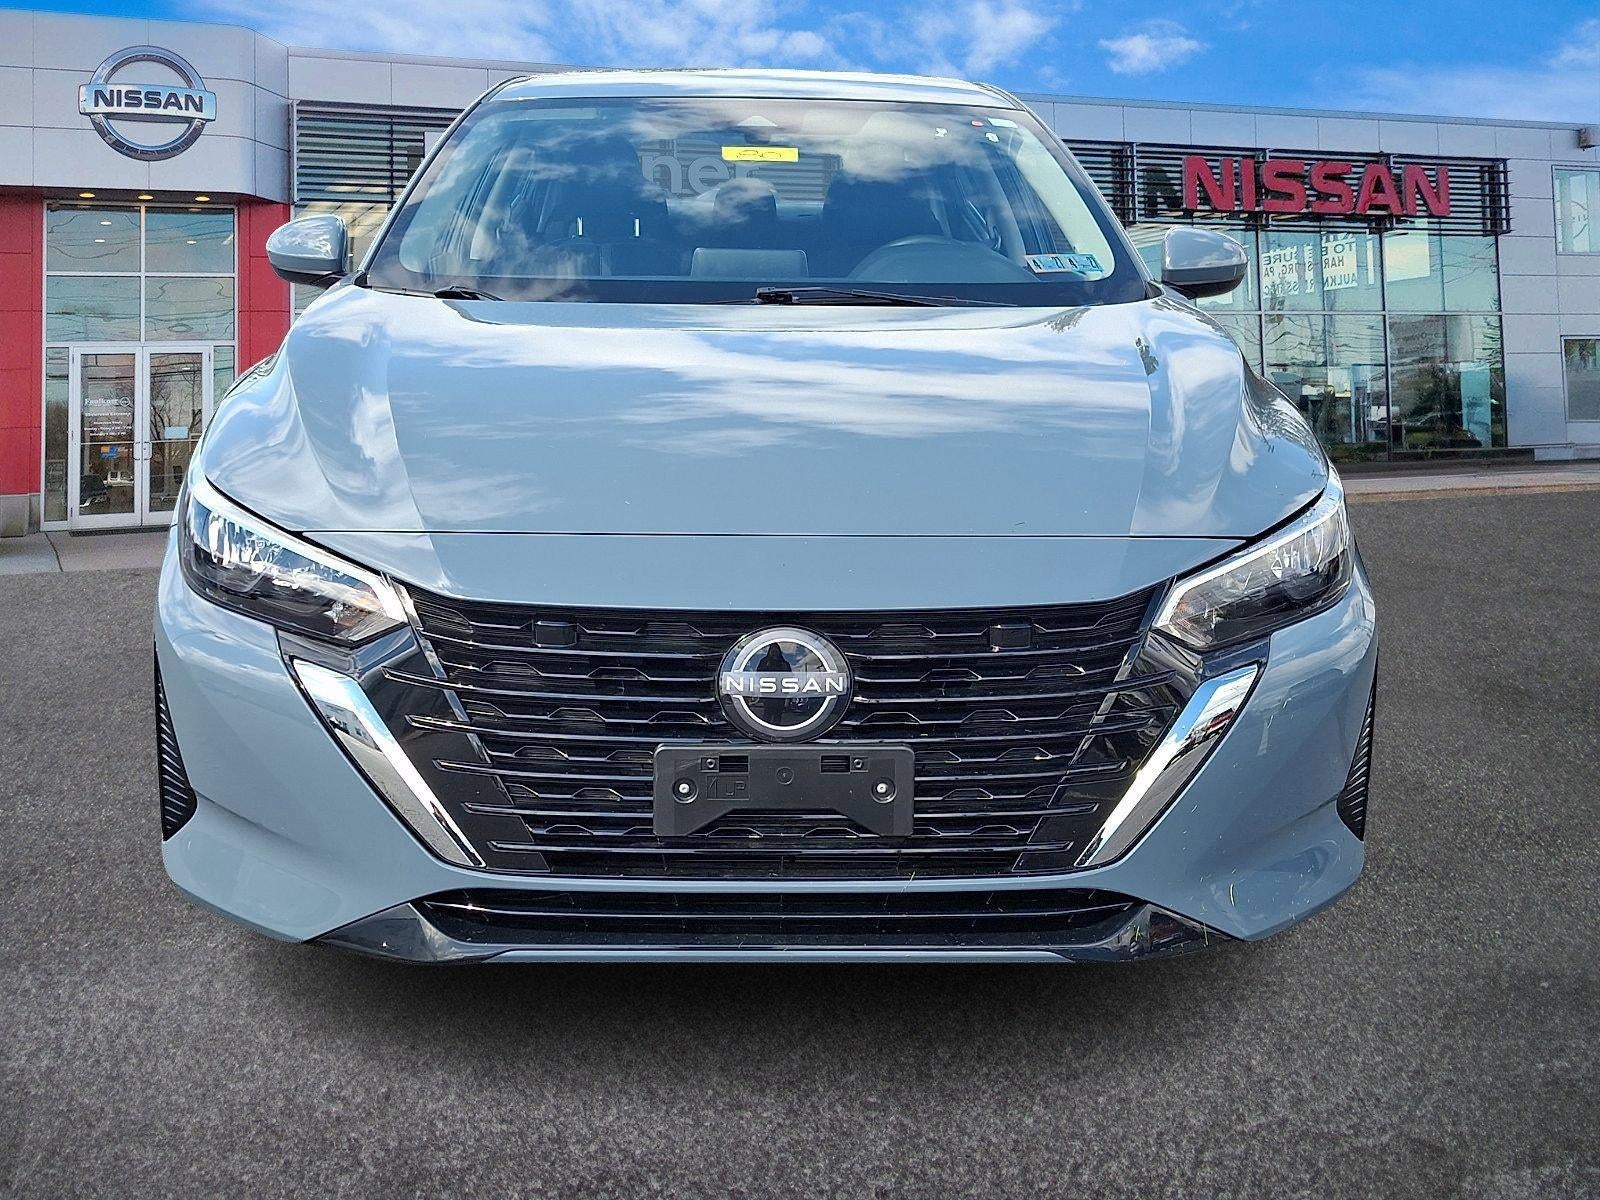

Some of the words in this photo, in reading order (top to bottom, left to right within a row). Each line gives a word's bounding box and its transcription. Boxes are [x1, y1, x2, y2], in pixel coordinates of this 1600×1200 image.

[93, 88, 204, 113] NISSAN
[1182, 155, 1451, 217] NISSAN
[726, 677, 844, 693] NISSAN
